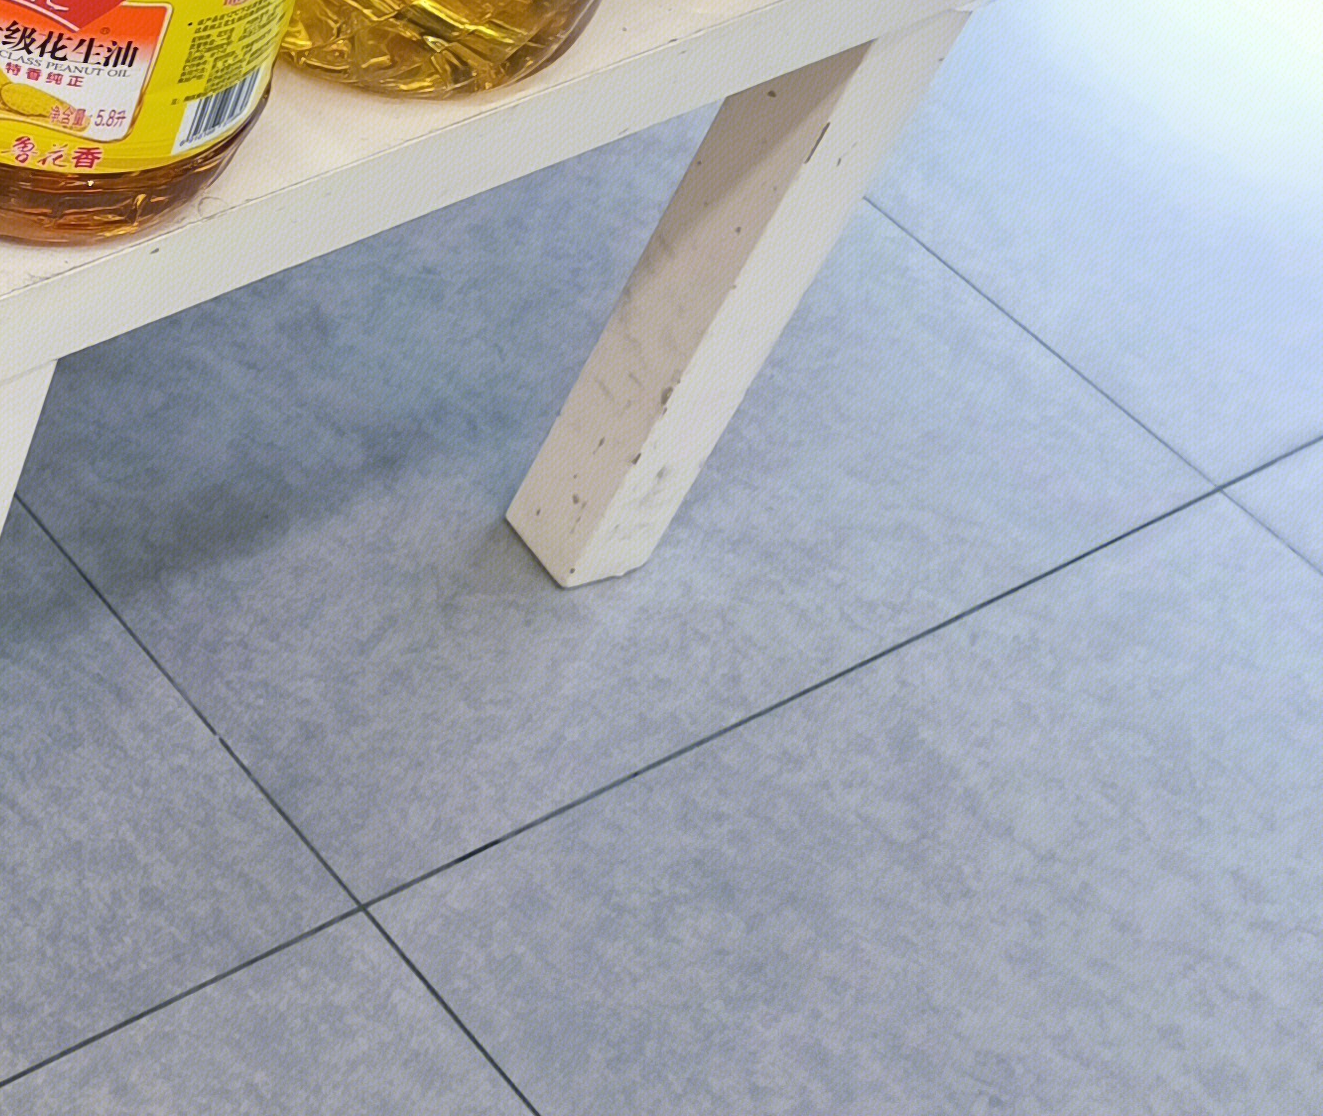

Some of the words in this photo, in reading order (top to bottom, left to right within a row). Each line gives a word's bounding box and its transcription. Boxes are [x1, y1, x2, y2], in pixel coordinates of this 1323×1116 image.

[4, 61, 85, 89] 特香纯正
[45, 61, 105, 78] PEANUT
[107, 67, 131, 79] OIL
[0, 134, 104, 170] 鲁花香
